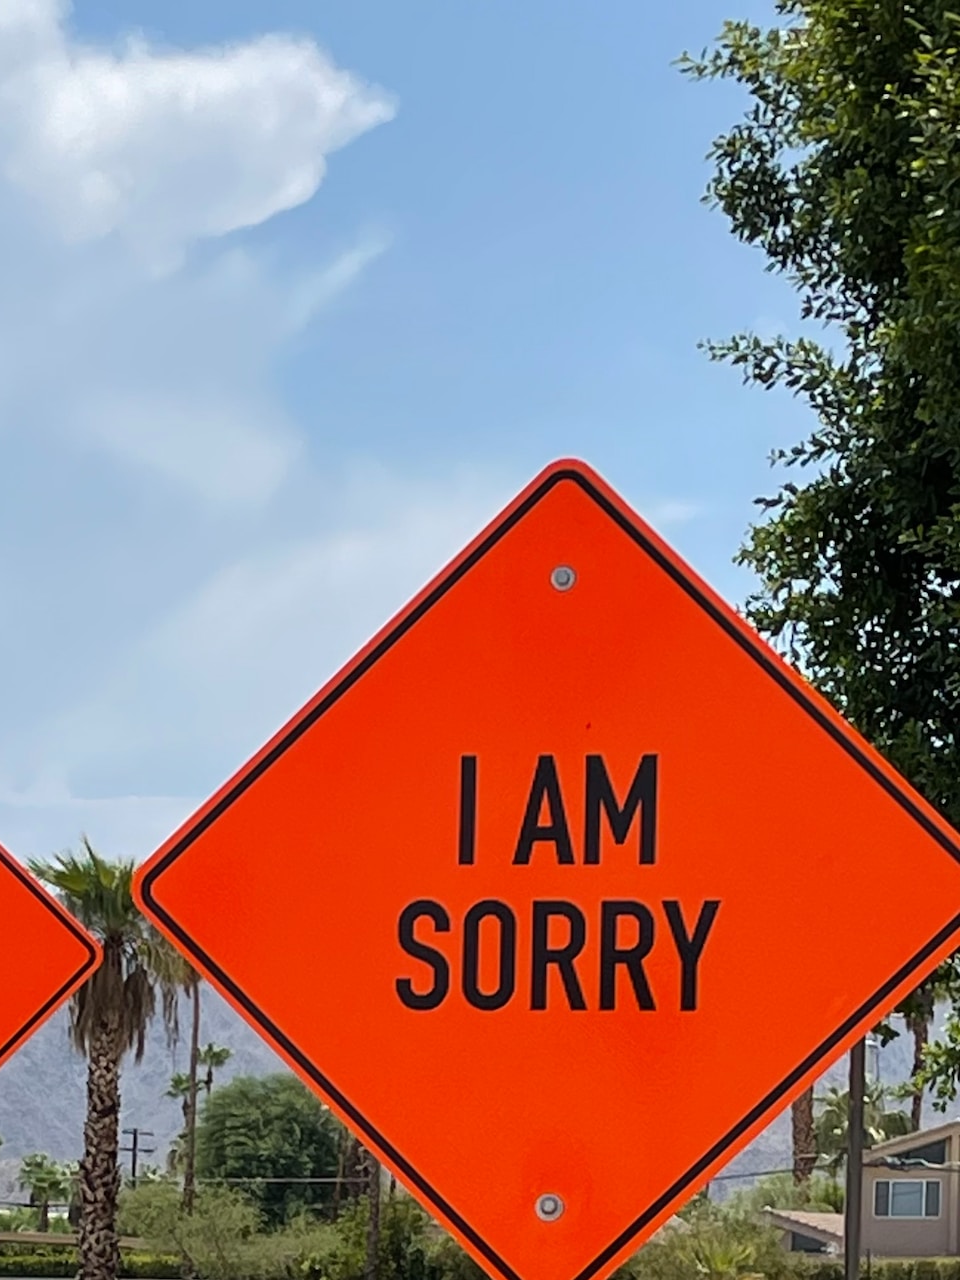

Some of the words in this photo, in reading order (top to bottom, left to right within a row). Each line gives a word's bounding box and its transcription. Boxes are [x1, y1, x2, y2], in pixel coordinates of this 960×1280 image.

[458, 755, 477, 865] I
[512, 753, 658, 865] AM
[395, 899, 721, 1012] SORRY
